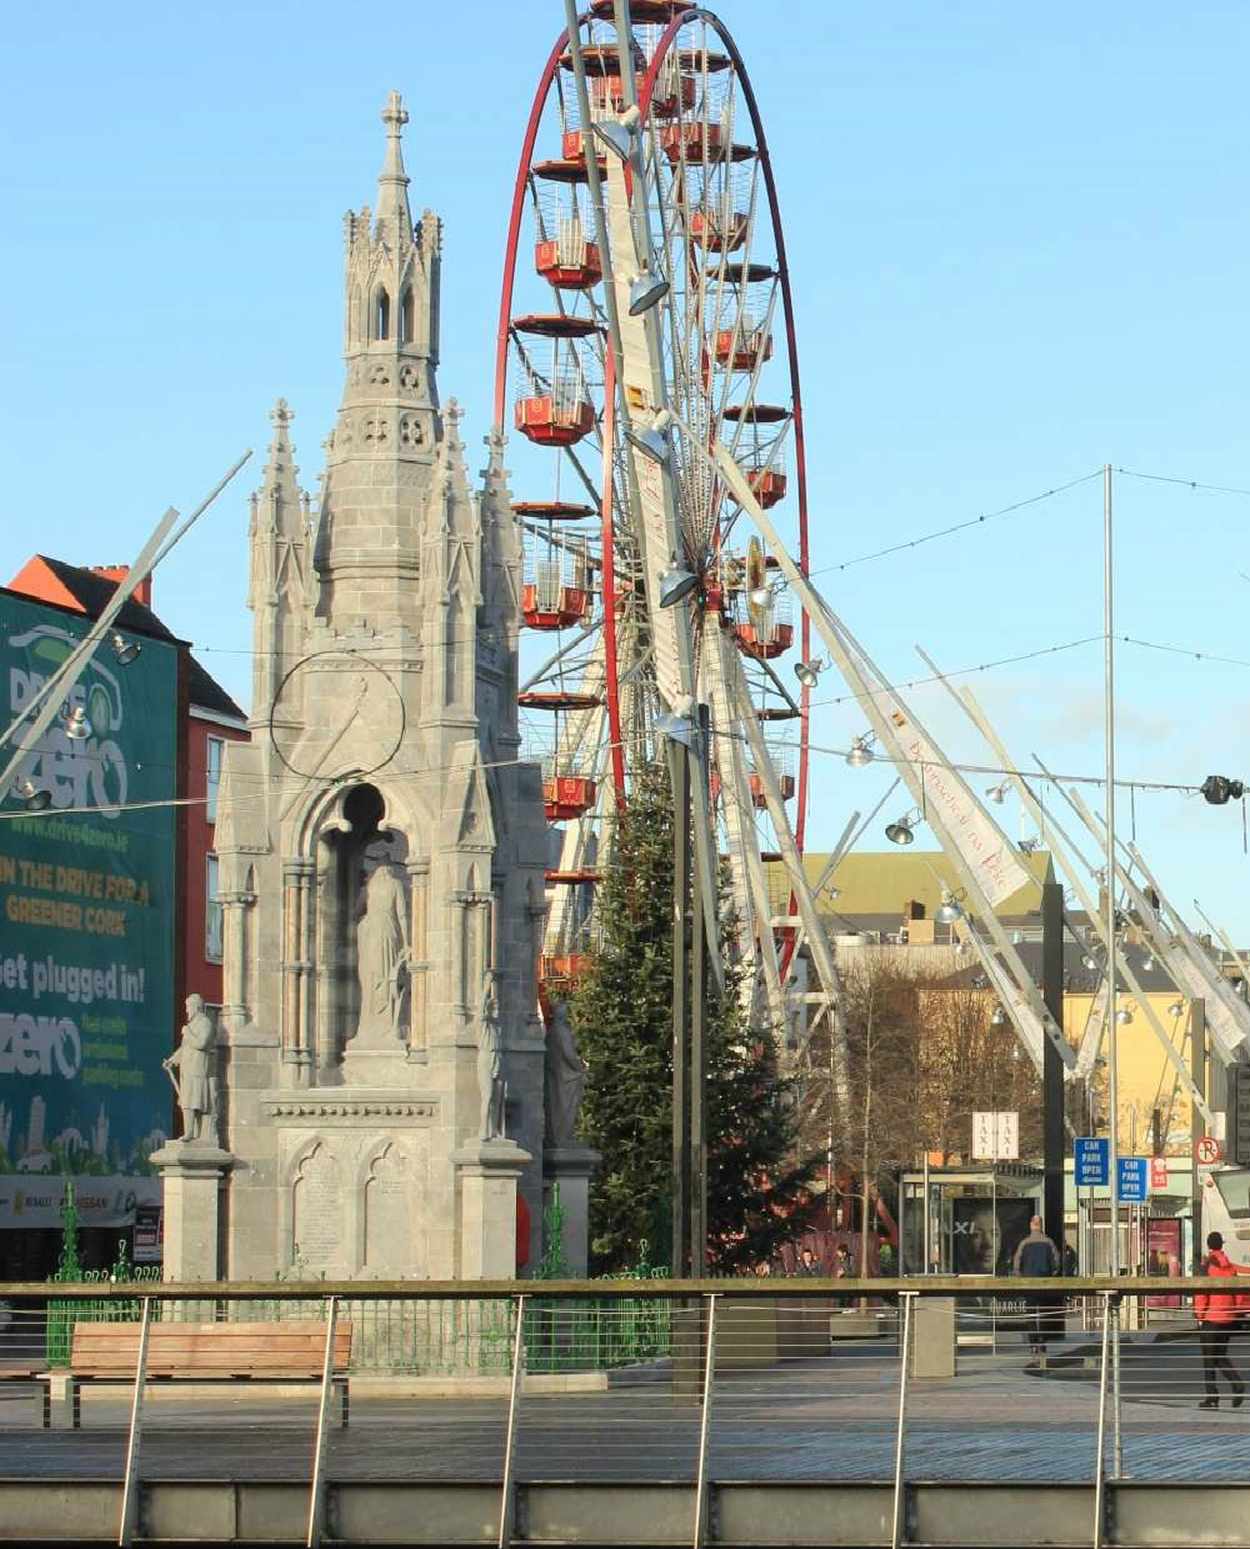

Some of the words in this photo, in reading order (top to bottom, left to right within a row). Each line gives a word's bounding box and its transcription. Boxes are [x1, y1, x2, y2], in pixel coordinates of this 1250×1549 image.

[19, 861, 56, 893] THE
[56, 865, 105, 899] DRIVE
[106, 875, 137, 904] FOR
[6, 894, 82, 930] GREENER
[84, 906, 127, 937] CORK
[0, 953, 28, 990] et
[33, 955, 118, 1004] plugged
[120, 964, 145, 1003] in!
[1084, 1140, 1100, 1150] CAR
[1081, 1153, 1101, 1163] PARK
[1081, 1165, 1102, 1175] OPEN
[1124, 1161, 1138, 1170] CAR
[1121, 1172, 1139, 1181] PARK
[1121, 1184, 1140, 1193] OPEN
